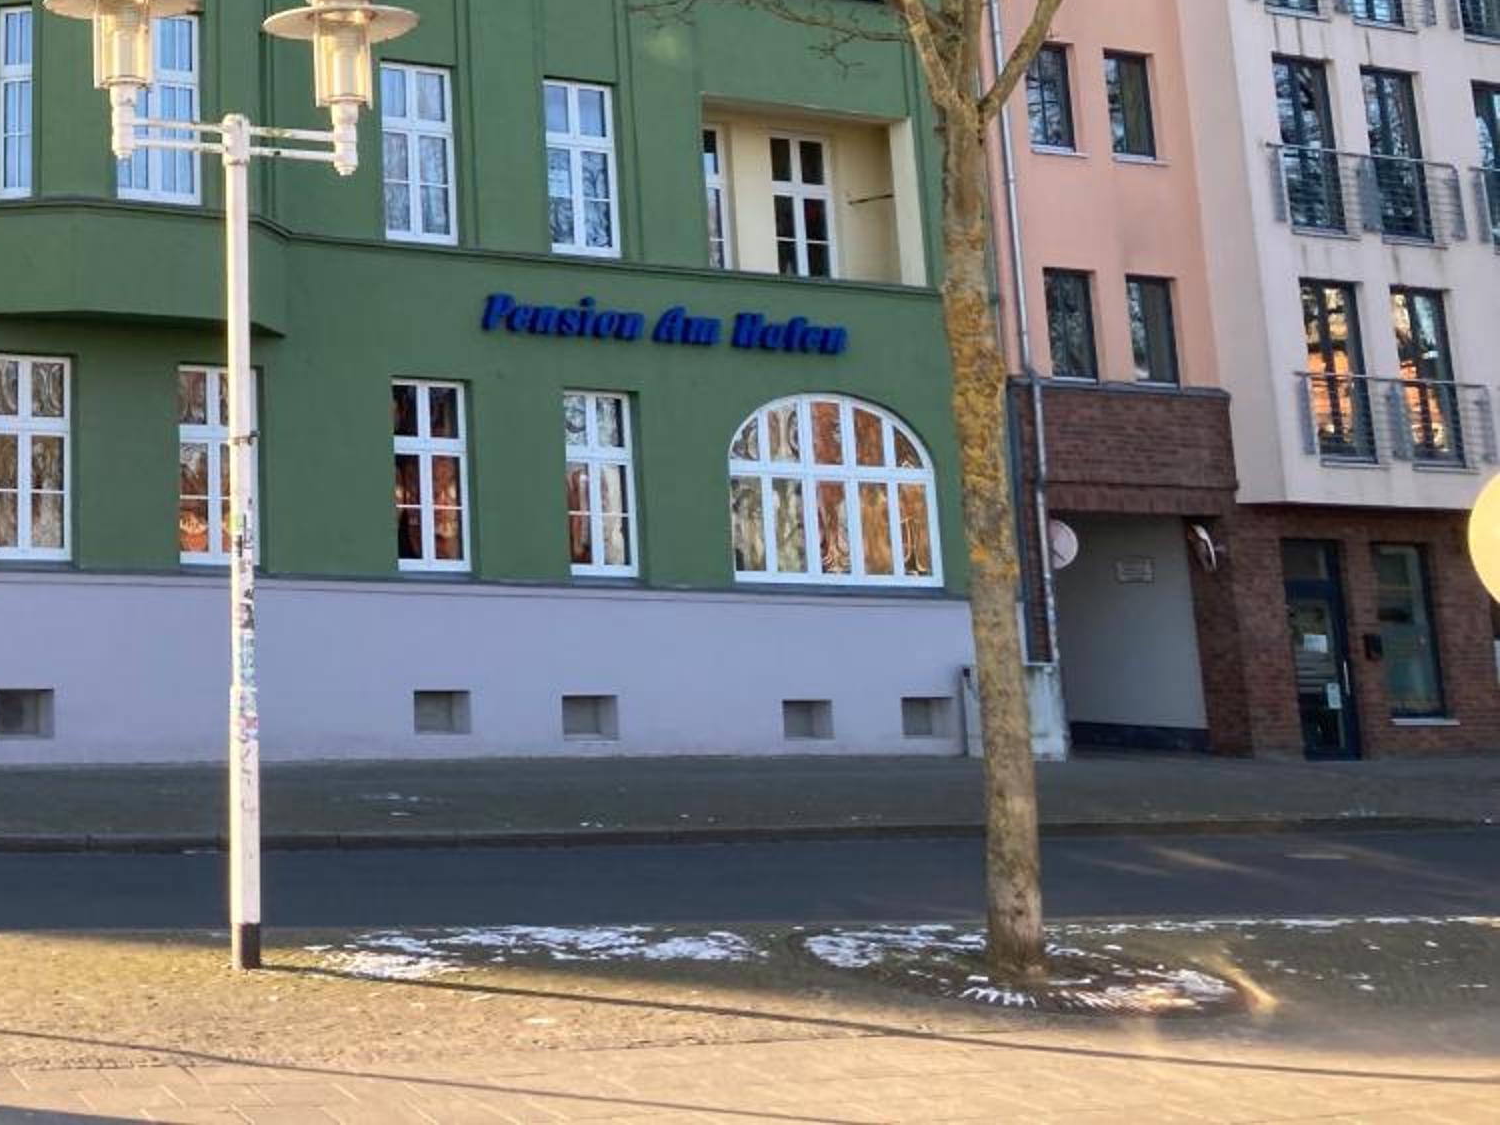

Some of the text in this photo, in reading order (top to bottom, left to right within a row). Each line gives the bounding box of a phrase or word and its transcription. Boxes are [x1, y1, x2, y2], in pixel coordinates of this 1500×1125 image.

[482, 293, 848, 355] Pension Am Hafen
